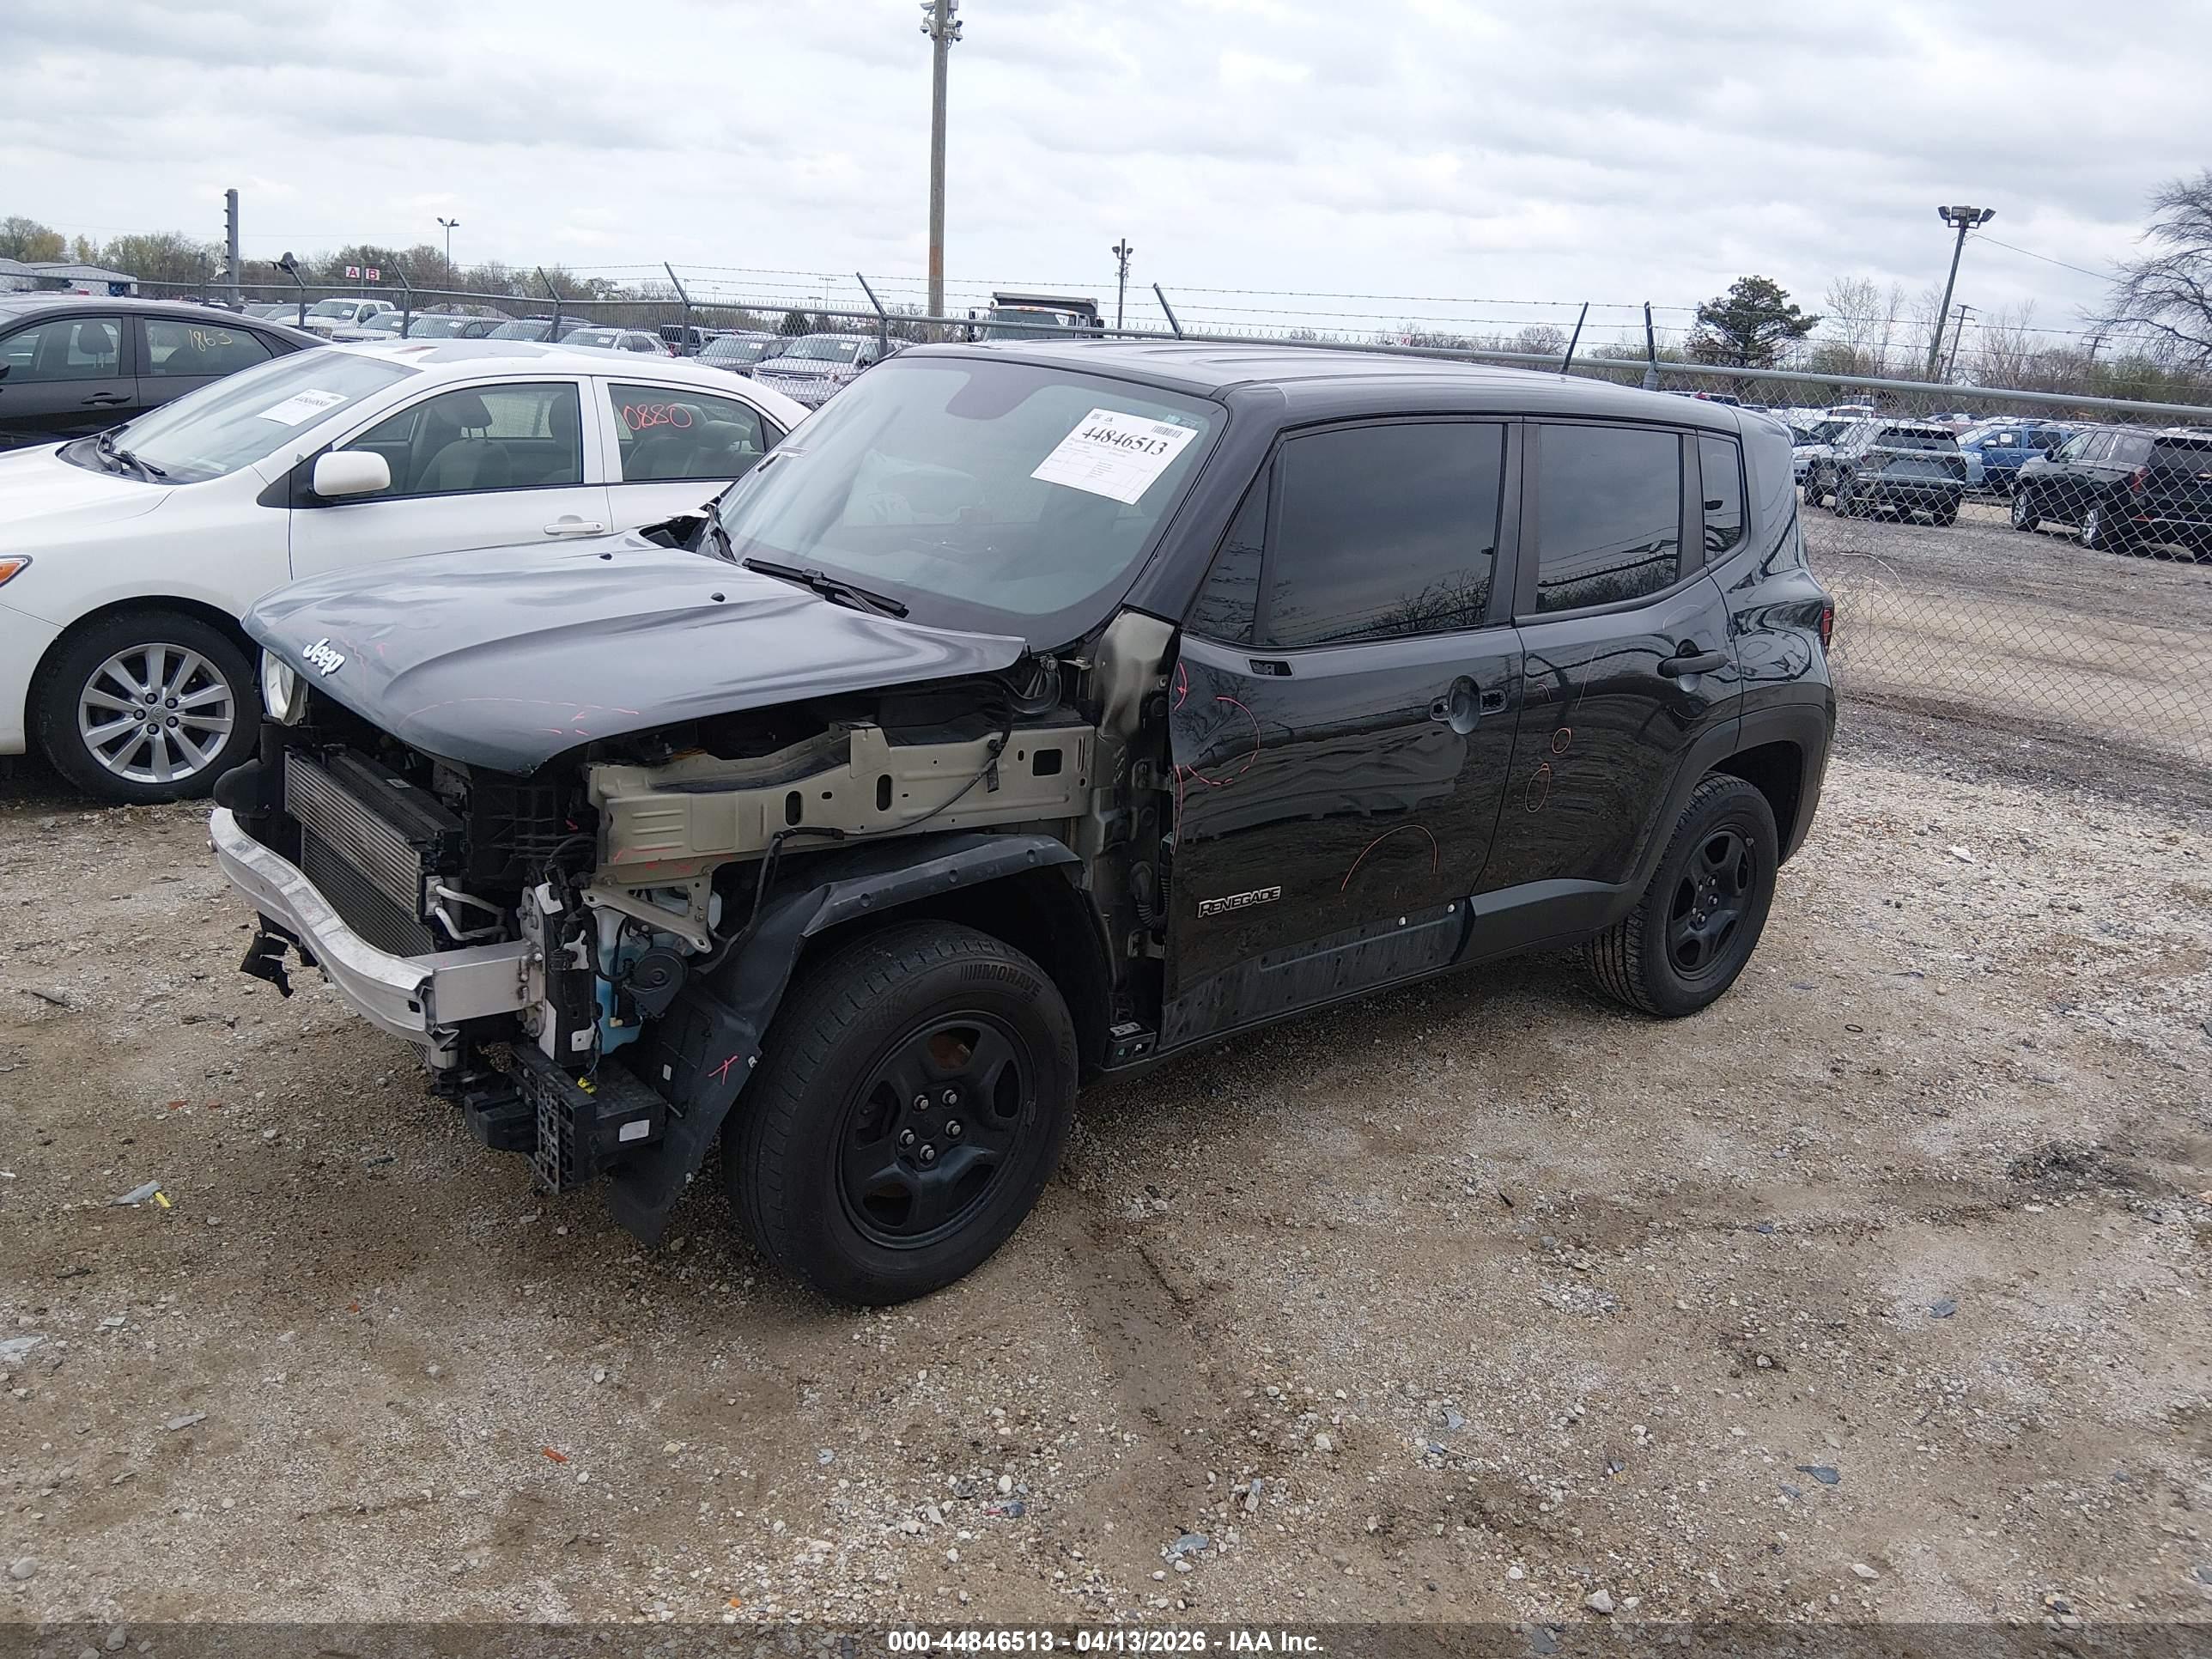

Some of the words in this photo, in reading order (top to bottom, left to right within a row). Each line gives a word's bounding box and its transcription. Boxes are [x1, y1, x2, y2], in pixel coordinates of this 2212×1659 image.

[348, 267, 358, 277] A
[368, 269, 378, 279] B
[188, 329, 233, 352] 1863
[623, 403, 692, 431] 0880
[1082, 426, 1168, 457] 44846513
[302, 637, 346, 677] Jeep
[1197, 885, 1282, 919] RENEGADE
